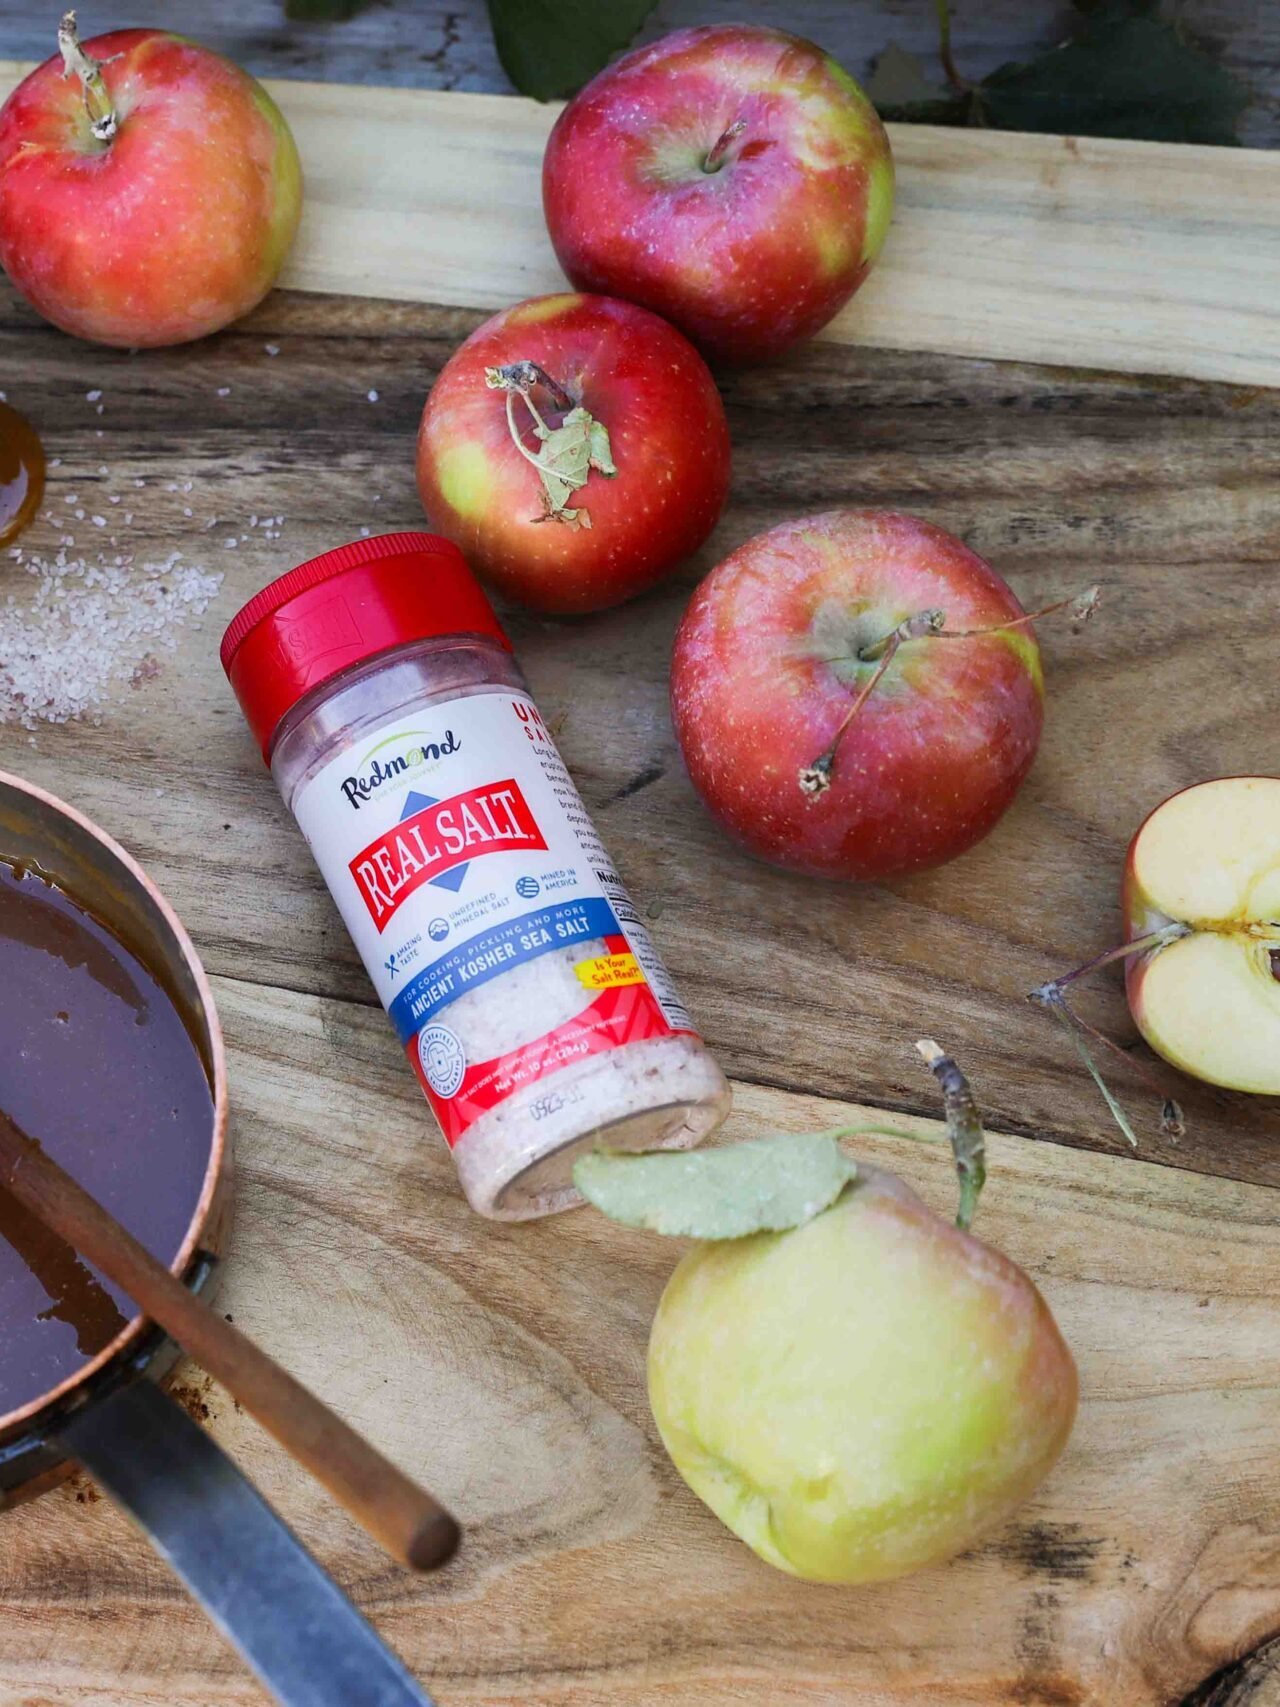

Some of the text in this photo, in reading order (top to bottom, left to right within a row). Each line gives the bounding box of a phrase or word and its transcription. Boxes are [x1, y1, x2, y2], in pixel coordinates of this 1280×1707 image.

[340, 730, 462, 810] Redmond
[357, 789, 529, 917] REAL SALT
[540, 868, 577, 882] MINED IN
[545, 879, 579, 892] AMERICA
[448, 892, 497, 920] UNREFINED
[453, 897, 511, 929] MINERAL SALT
[396, 933, 422, 959] AMAZING
[400, 948, 420, 967] TASTE
[403, 905, 586, 1004] FOR COOKING, PICKLING AND MORE
[410, 916, 591, 1020] ANCIENT KOSHER SEA SALT
[594, 957, 626, 971] Is Your
[592, 972, 614, 985] Salt
[494, 1077, 513, 1094] Net
[511, 1070, 529, 1085] Wt.
[528, 1061, 541, 1075] 10
